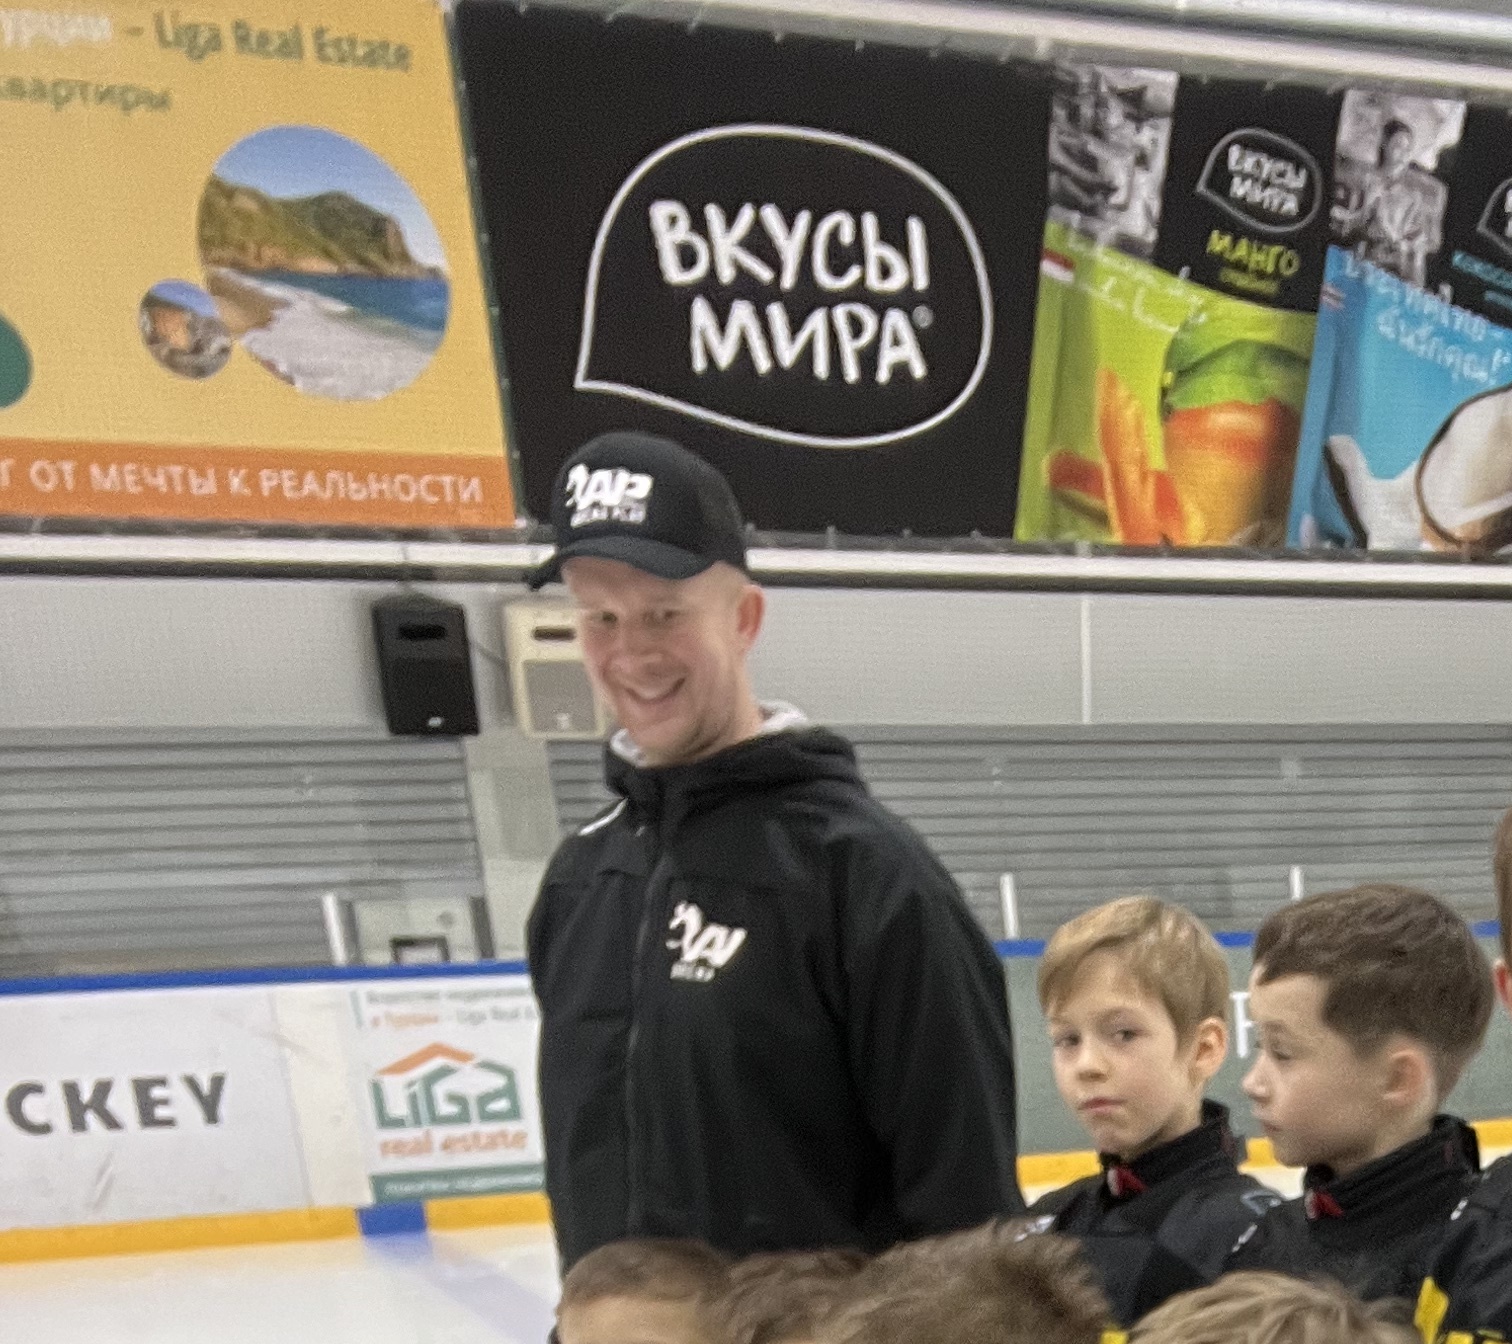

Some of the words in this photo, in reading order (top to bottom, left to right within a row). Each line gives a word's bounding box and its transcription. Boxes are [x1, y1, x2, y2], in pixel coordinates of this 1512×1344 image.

[649, 199, 931, 294] ВКУСЫ
[690, 294, 928, 385] МИРА
[29, 458, 77, 491] ОТ
[90, 462, 217, 496] МЕЧТЫ
[228, 467, 252, 498] К
[259, 468, 484, 504] РЕАЛЬНОСТИ
[2, 1071, 227, 1137] CKEY
